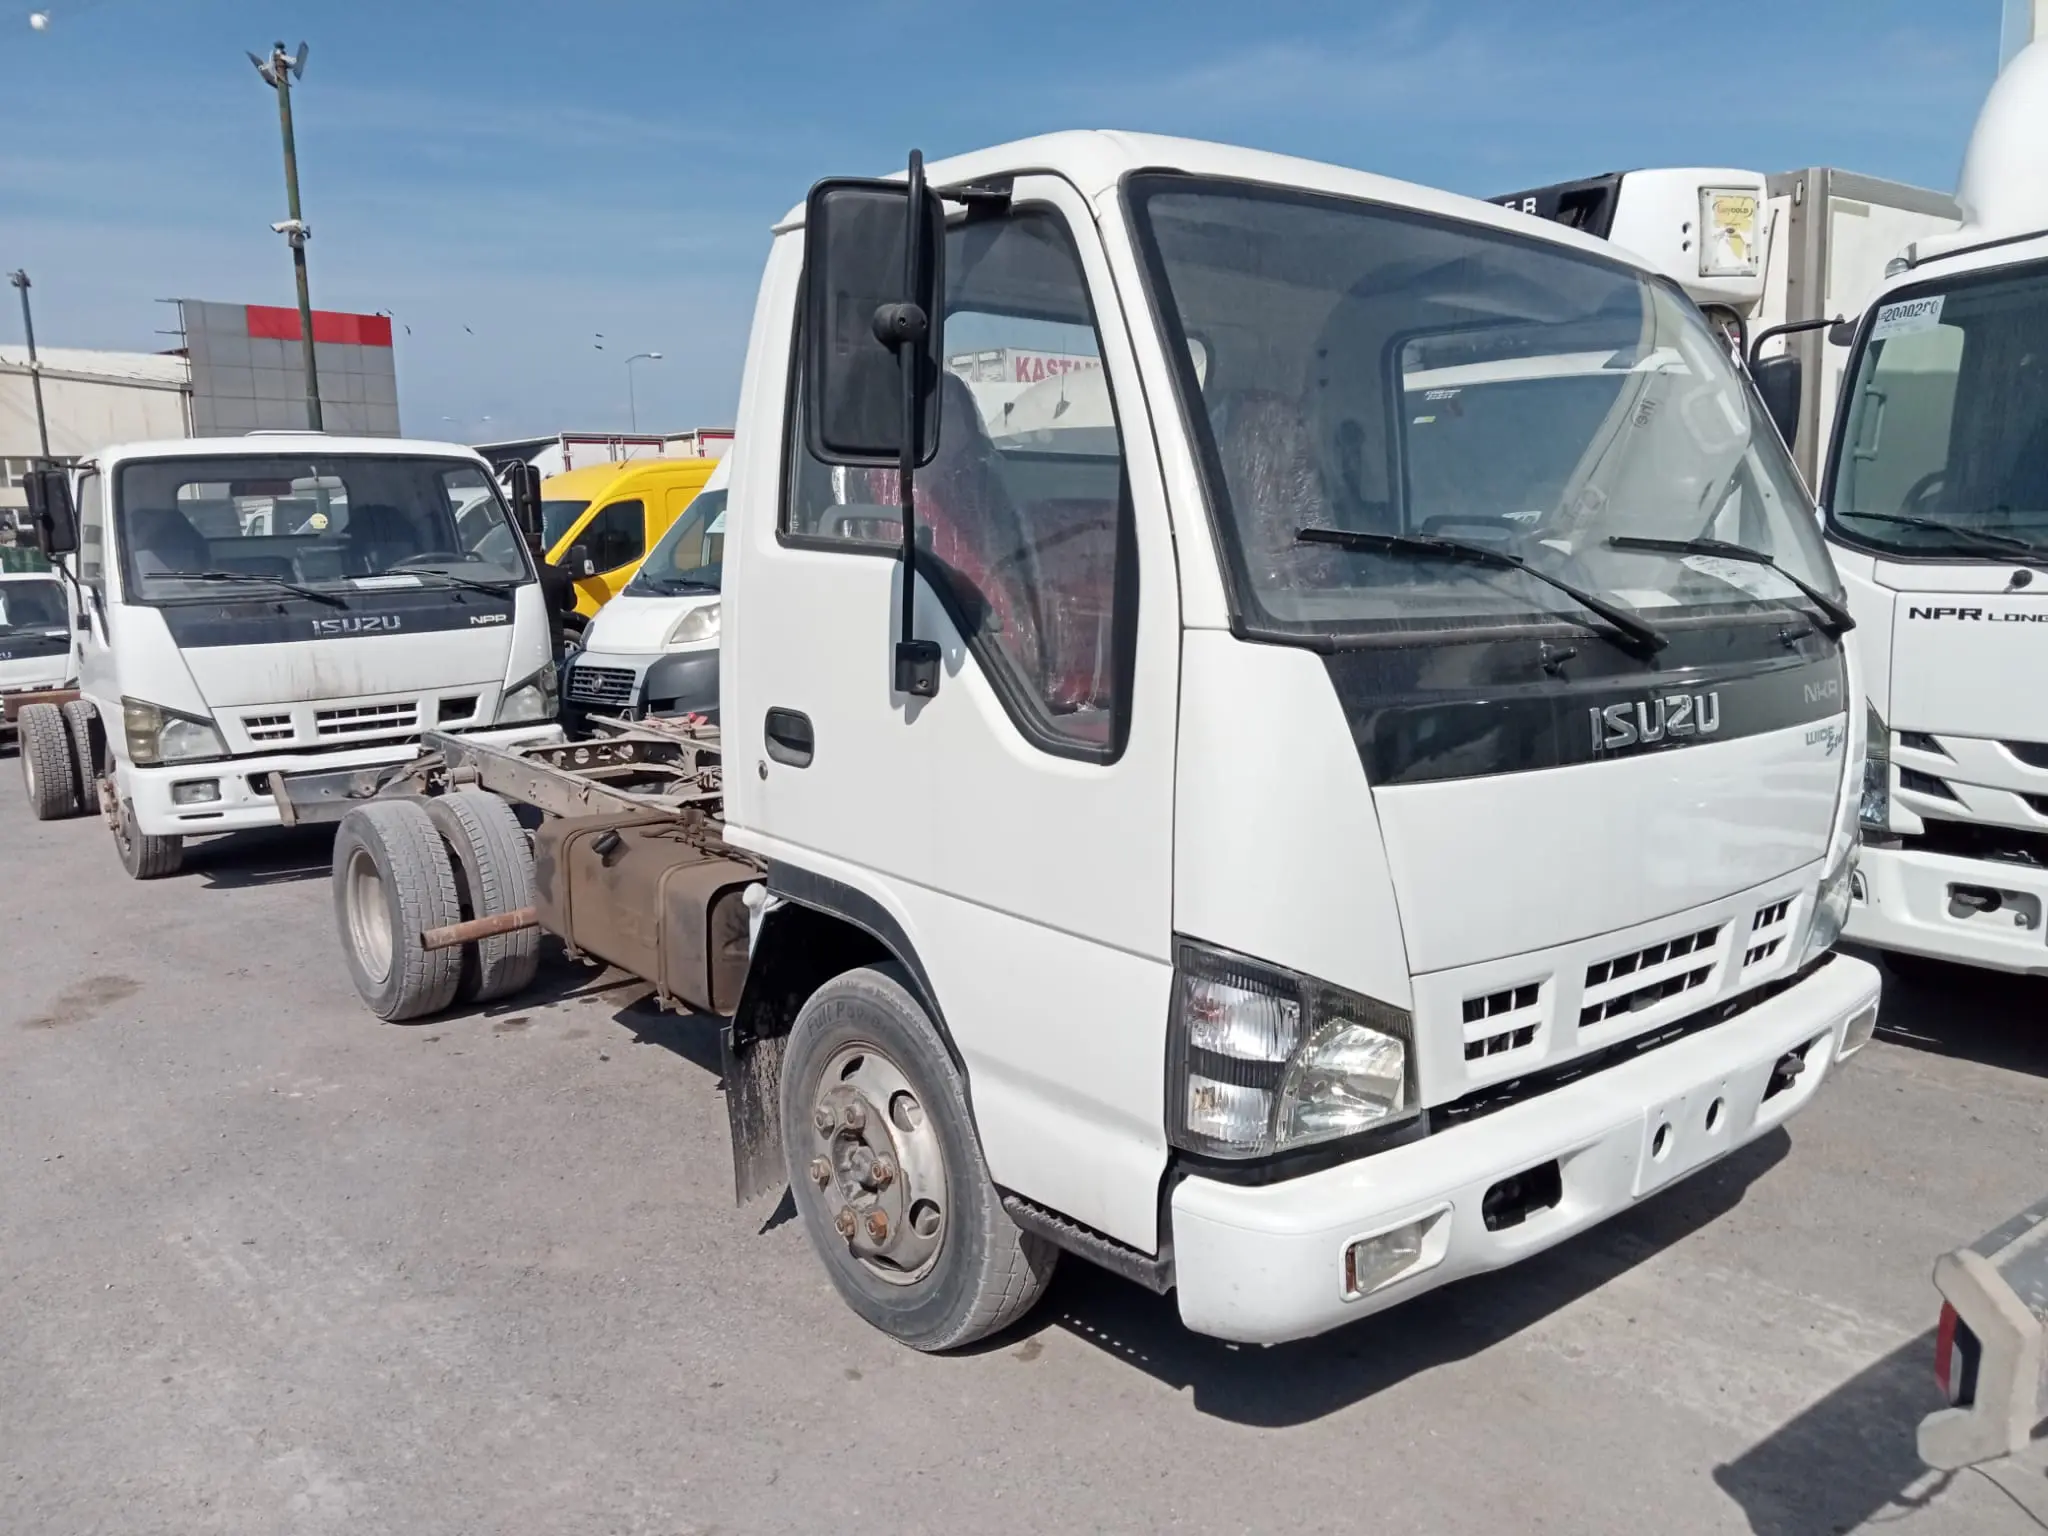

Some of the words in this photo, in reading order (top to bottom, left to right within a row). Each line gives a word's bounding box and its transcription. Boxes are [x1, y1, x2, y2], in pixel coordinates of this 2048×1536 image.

[470, 614, 507, 625] NPR
[1909, 607, 1982, 621] NPR
[312, 615, 401, 637] ISUZU
[1589, 692, 1719, 751] ISUZU
